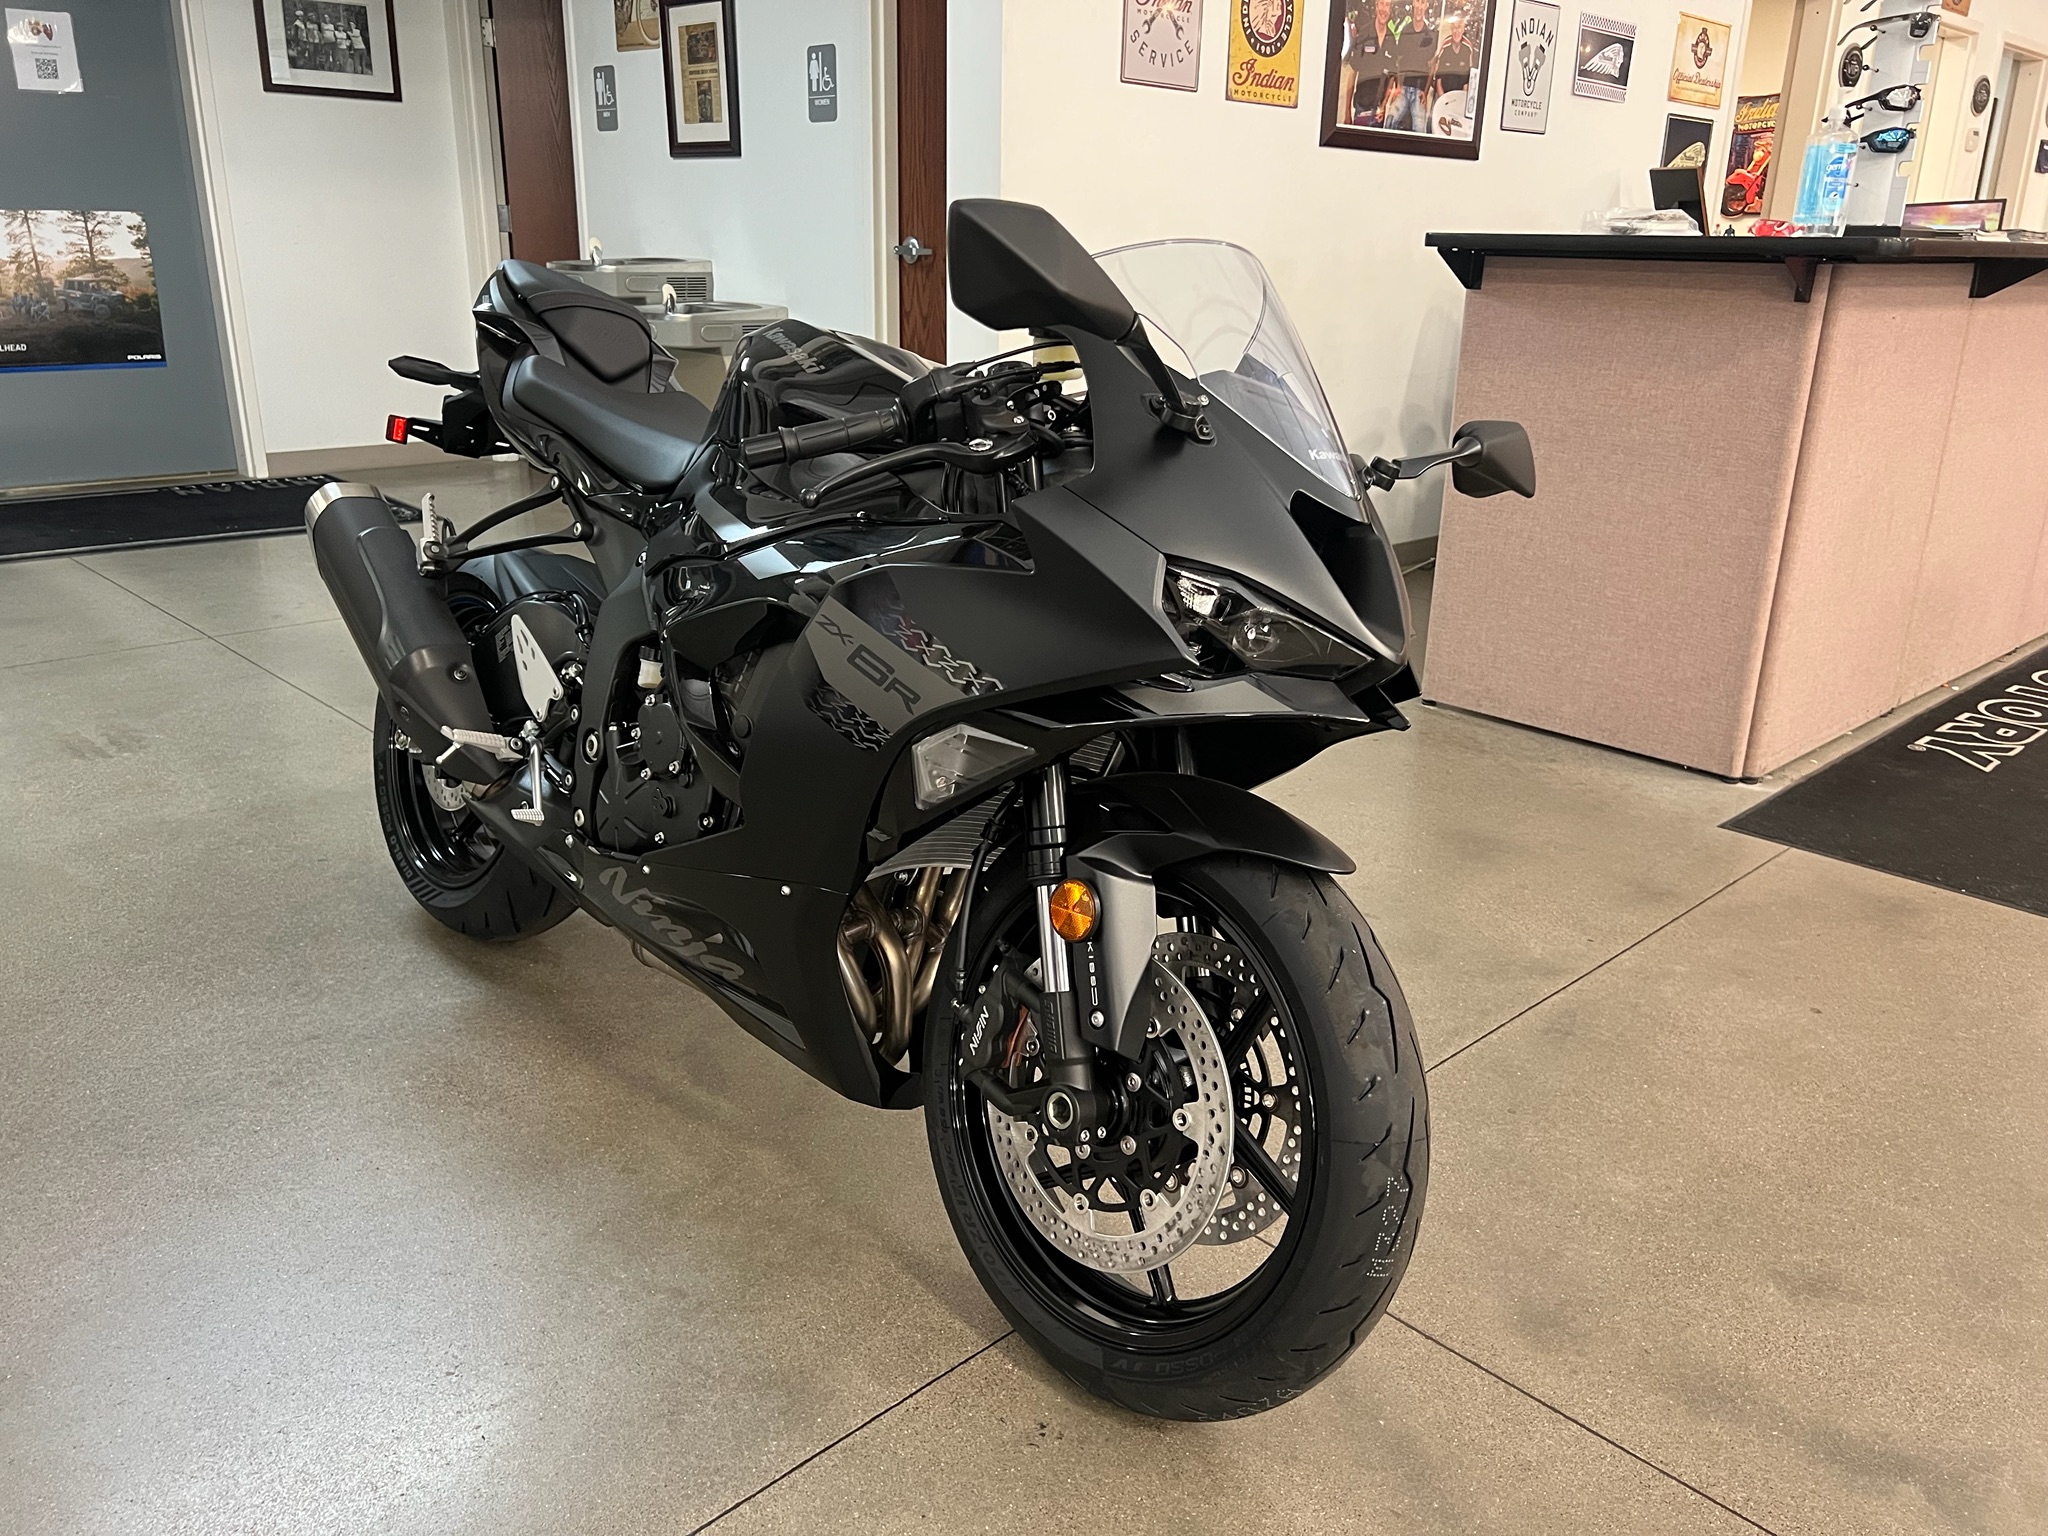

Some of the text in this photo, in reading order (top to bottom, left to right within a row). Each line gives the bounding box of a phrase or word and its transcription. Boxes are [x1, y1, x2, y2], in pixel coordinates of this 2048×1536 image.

[1255, 42, 1275, 54] 1901
[1515, 18, 1554, 47] INDIAN
[1130, 29, 1194, 68] SERVICE
[1232, 58, 1295, 91] Indian
[1233, 89, 1292, 102] MOTORCYCLE
[1511, 99, 1542, 110] MOTORCYCLE
[762, 327, 826, 373] Kawasaki
[599, 866, 745, 981] Ninja
